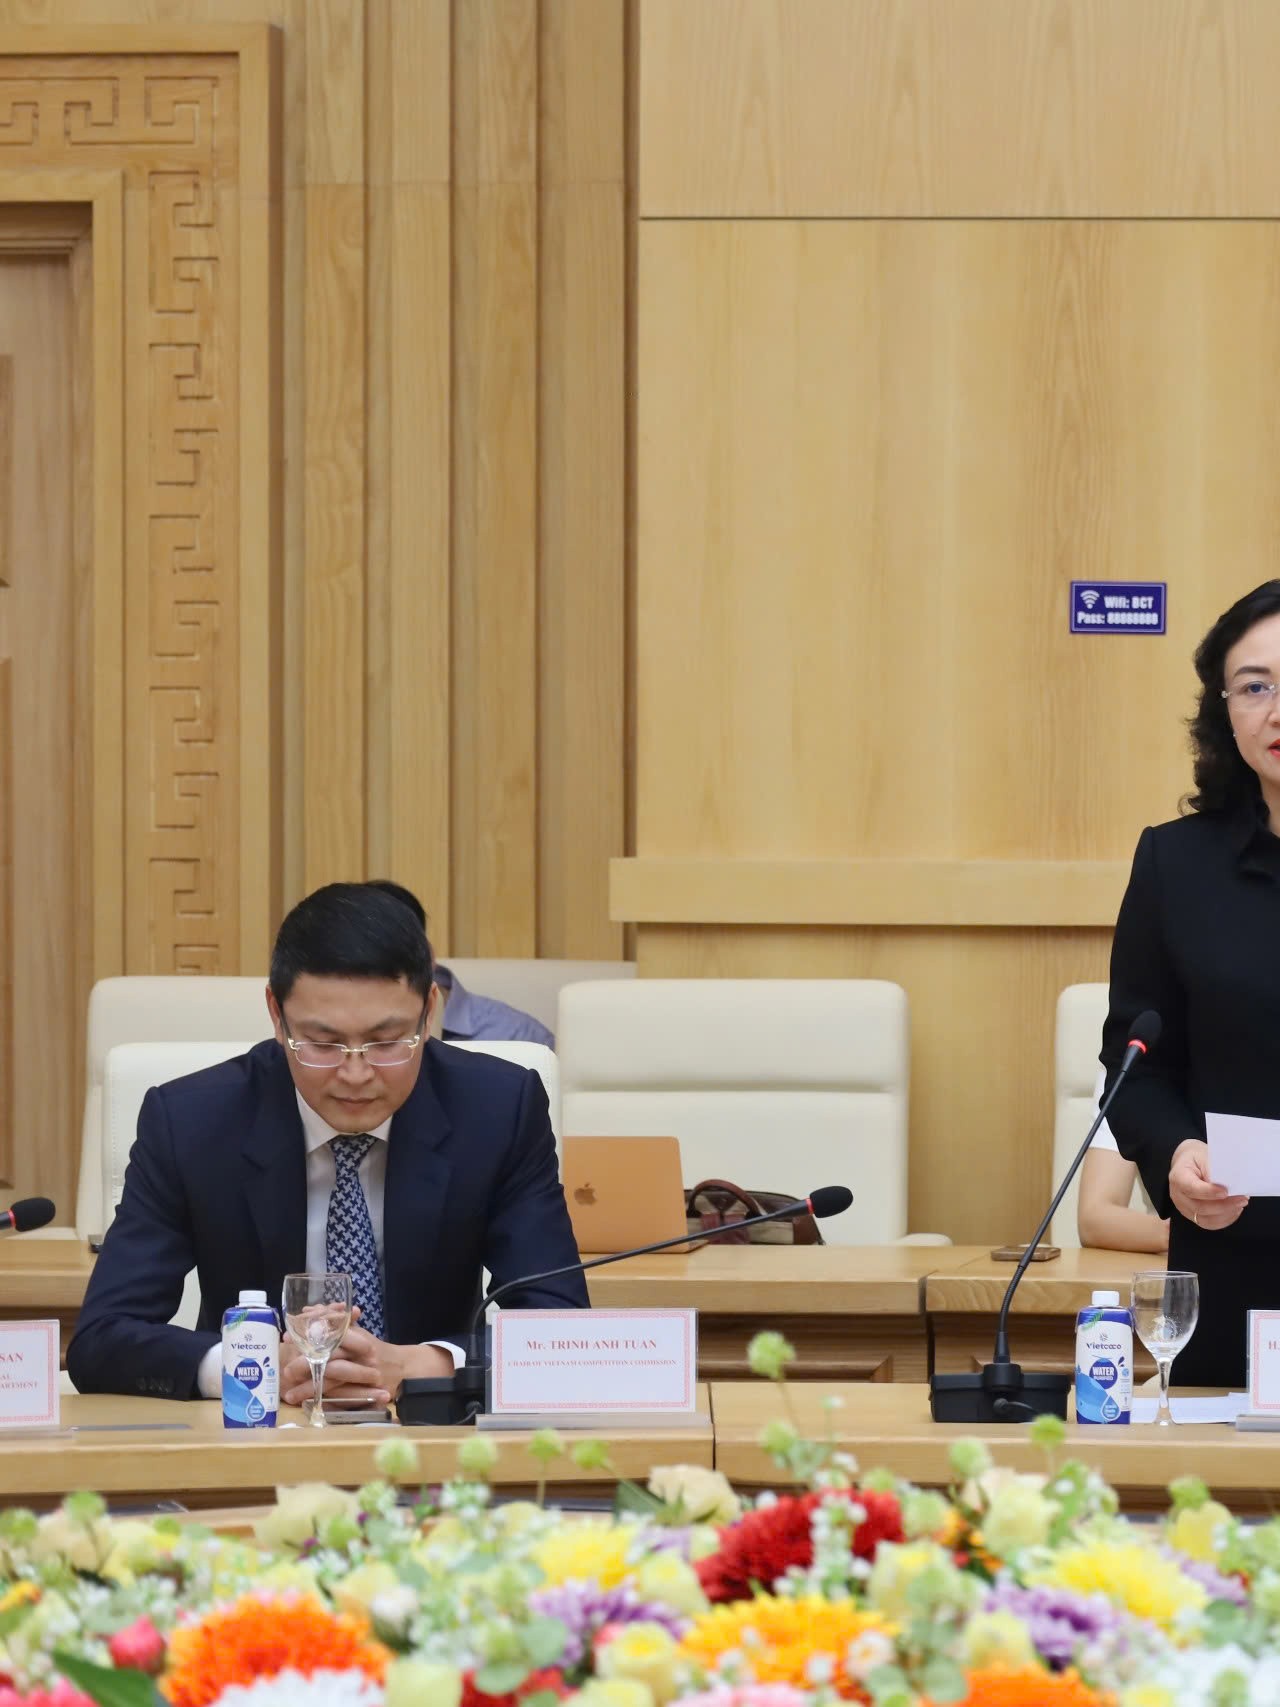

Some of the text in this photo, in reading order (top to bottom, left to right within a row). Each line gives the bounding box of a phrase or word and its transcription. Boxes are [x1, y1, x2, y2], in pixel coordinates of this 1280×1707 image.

[1077, 611, 1105, 624] Pass:
[230, 1342, 267, 1350] Vietcoco
[527, 1339, 657, 1350] Mr. TRINH ANH TUAN
[1086, 1342, 1122, 1350] Vietcoco
[237, 1366, 260, 1377] WATER
[1092, 1366, 1115, 1377] WATER
